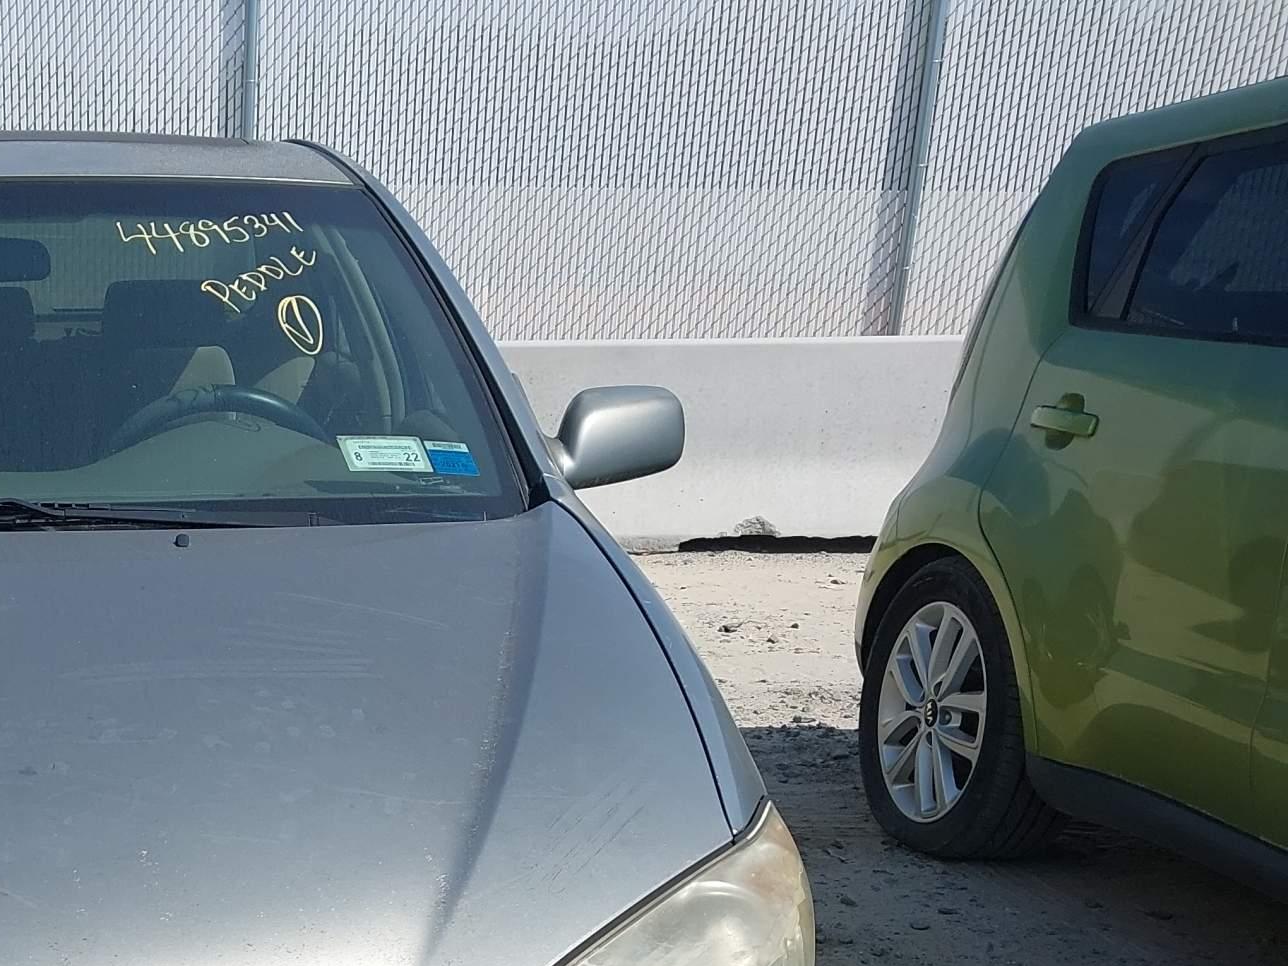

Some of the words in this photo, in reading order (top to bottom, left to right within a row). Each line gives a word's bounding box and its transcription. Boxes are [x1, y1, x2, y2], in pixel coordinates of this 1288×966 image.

[116, 211, 304, 255] 44895341
[200, 246, 316, 313] PEDDLE
[353, 451, 363, 461] 8
[403, 452, 421, 462] 22
